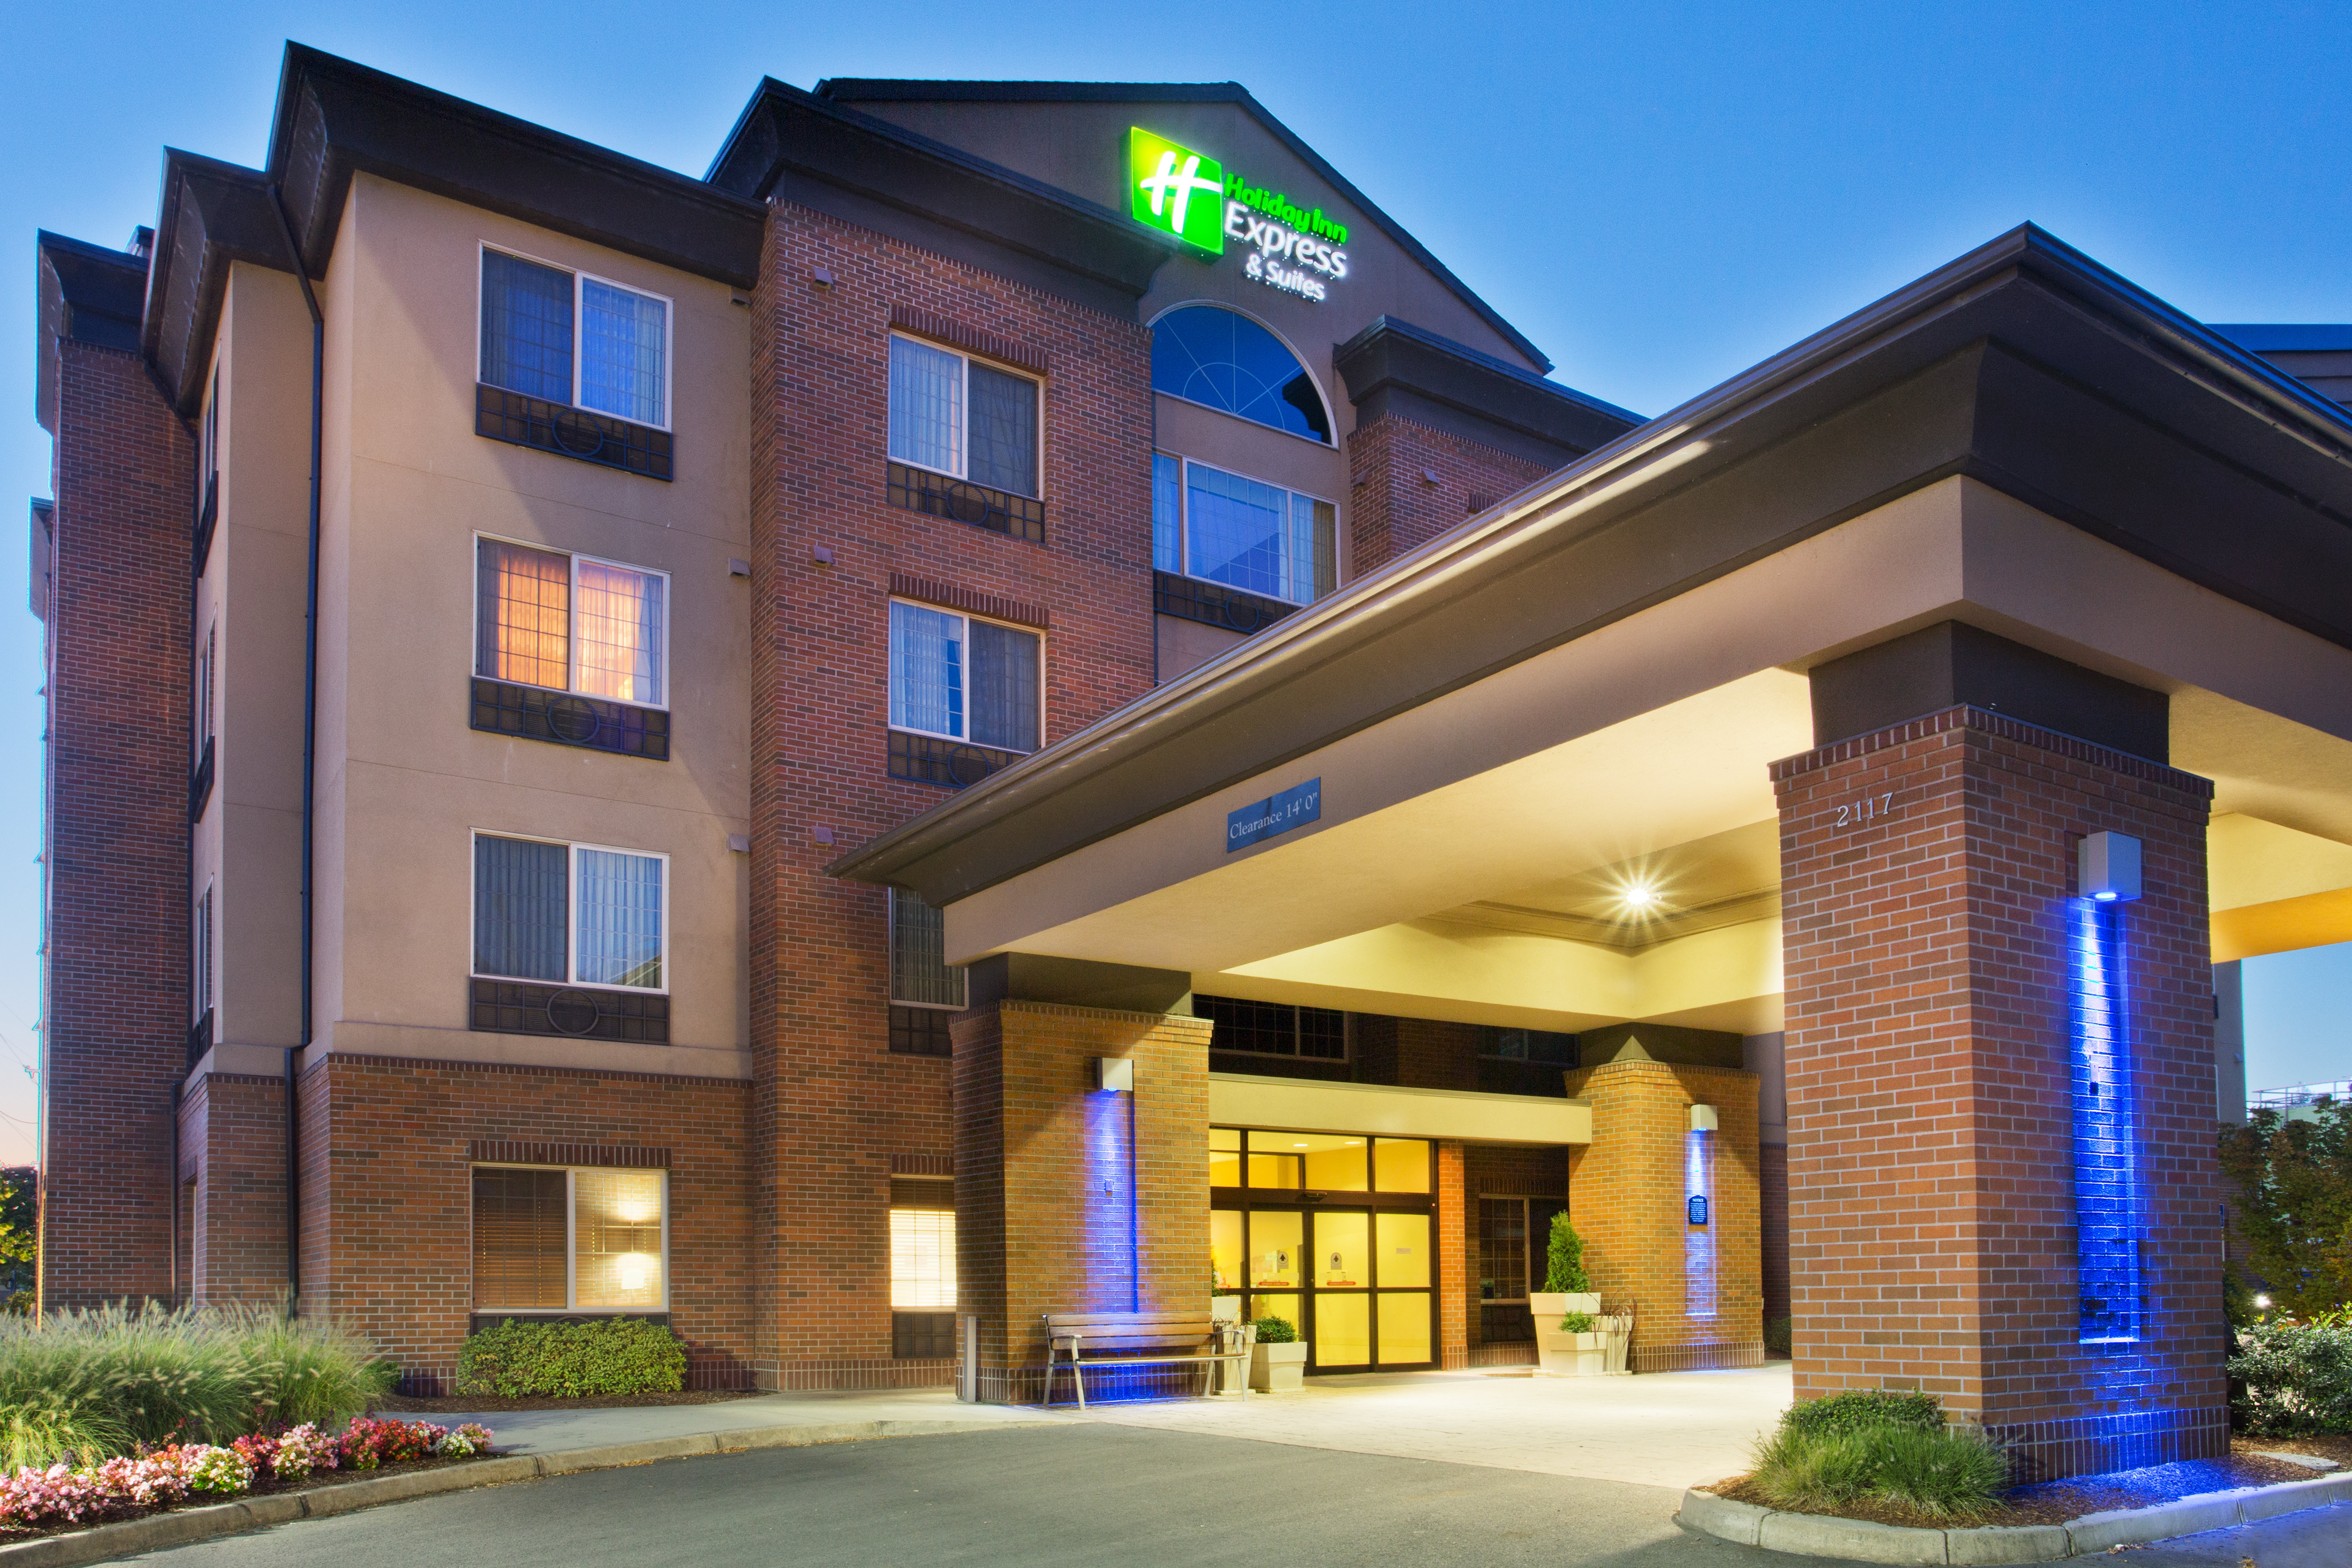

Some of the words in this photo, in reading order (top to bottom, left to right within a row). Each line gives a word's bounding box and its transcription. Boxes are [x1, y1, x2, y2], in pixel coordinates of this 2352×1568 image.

[1224, 173, 1310, 232] Holiday
[1312, 209, 1347, 243] Inn
[1225, 201, 1347, 277] Express
[1245, 254, 1262, 276] &
[1265, 261, 1325, 300] Suites
[1230, 811, 1283, 839] Clearance
[1837, 792, 1893, 827] 2117
